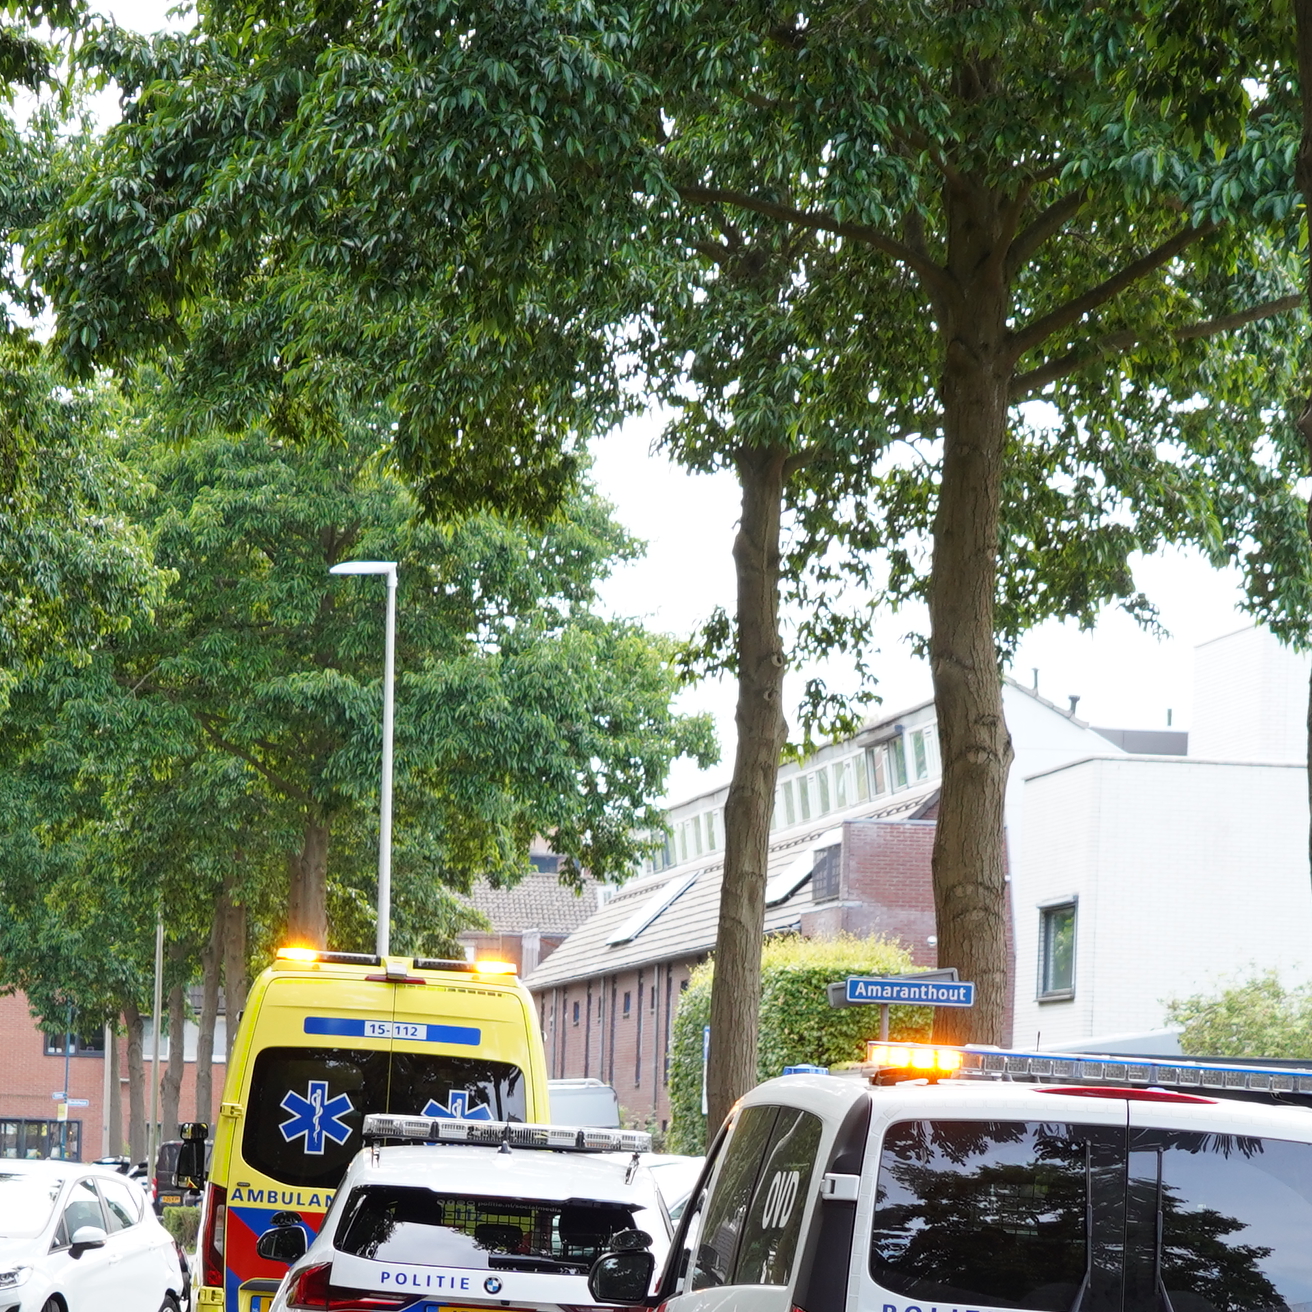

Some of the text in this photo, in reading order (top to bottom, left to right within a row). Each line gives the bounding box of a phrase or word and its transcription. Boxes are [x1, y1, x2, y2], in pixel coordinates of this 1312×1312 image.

[855, 981, 966, 1001] Amaranthout
[369, 1023, 418, 1037] 15-112
[762, 1170, 800, 1230] OVD
[380, 1271, 470, 1290] POLITIE
